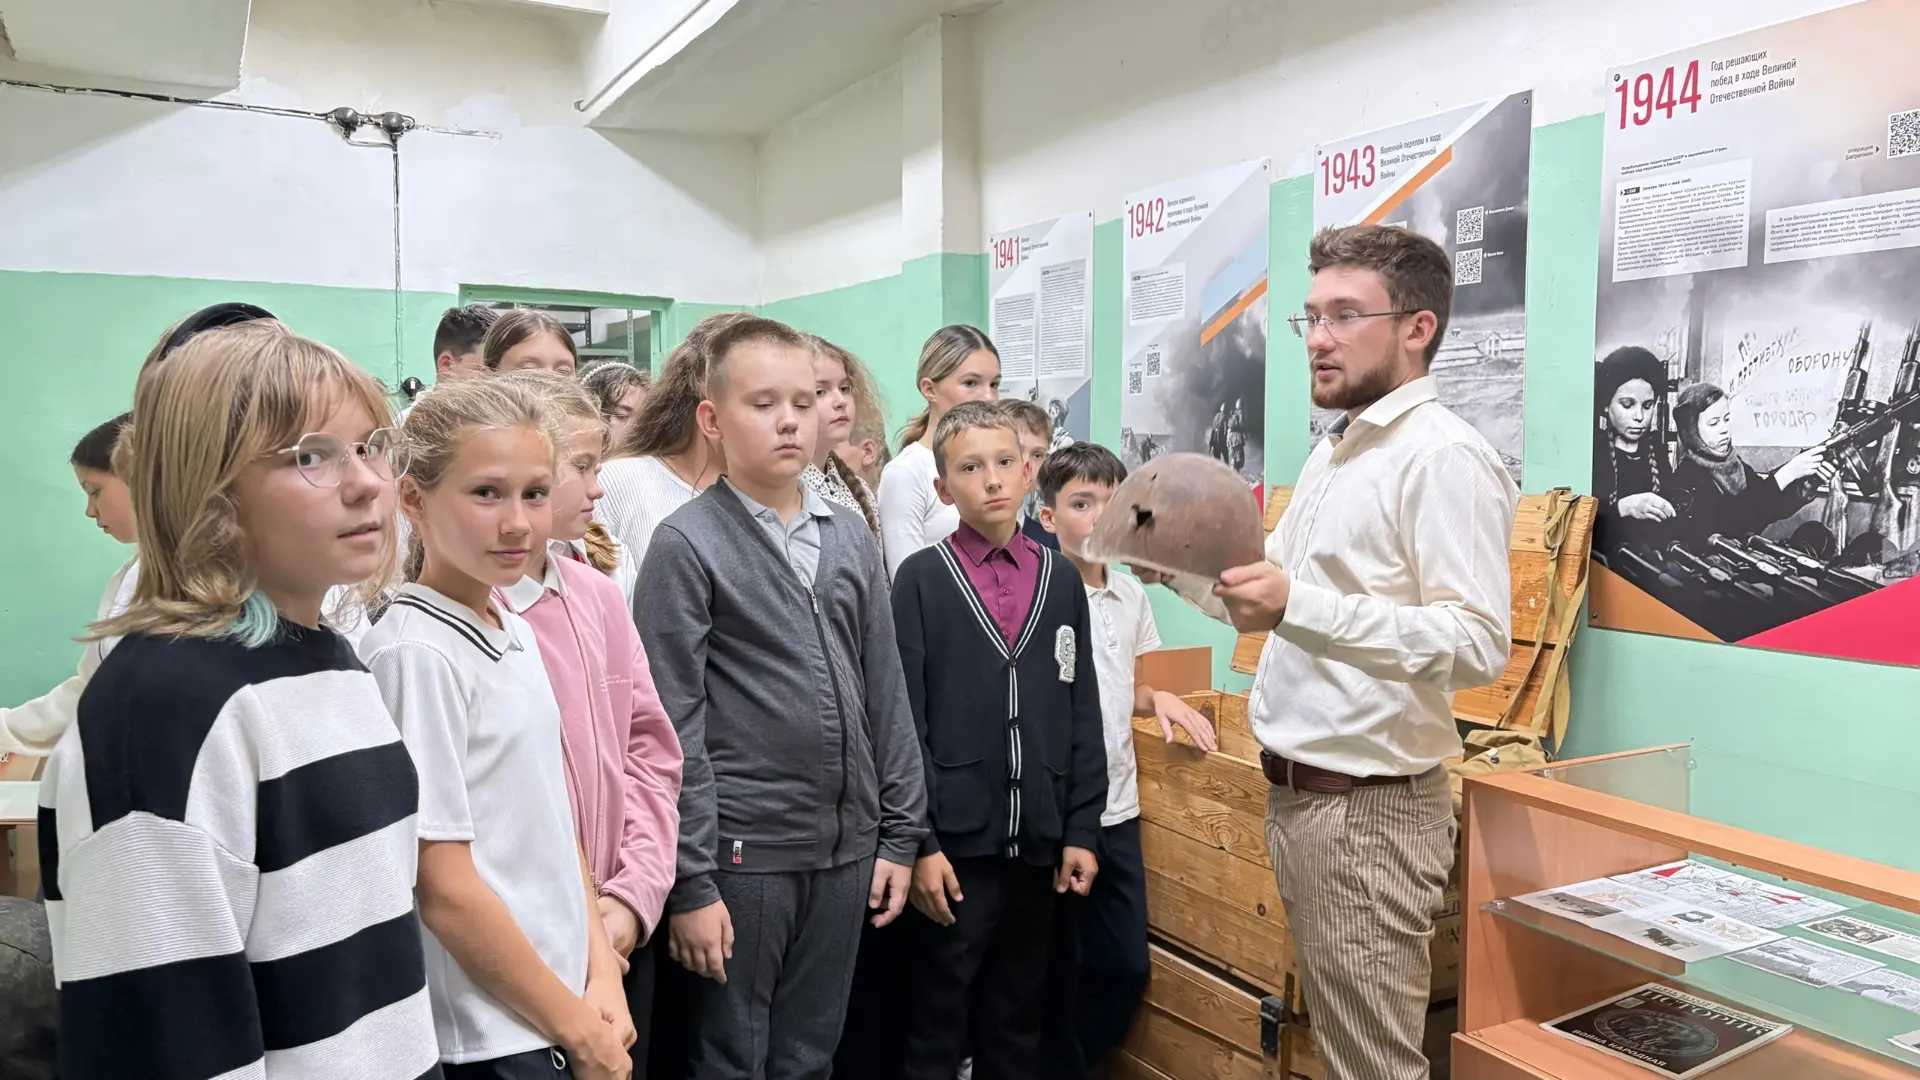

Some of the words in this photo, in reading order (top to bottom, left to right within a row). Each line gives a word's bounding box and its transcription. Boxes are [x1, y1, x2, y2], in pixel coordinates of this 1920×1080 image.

[1711, 60, 1724, 72] Год
[1726, 50, 1768, 70] решающих
[1615, 60, 1702, 130] 1944
[1710, 75, 1733, 88] побед
[1735, 74, 1740, 82] в
[1742, 69, 1760, 80] ходе
[1710, 82, 1767, 104] Отечественной
[1768, 78, 1795, 91] Войны
[1320, 144, 1376, 196] 1943
[1128, 198, 1164, 239] 1942
[994, 236, 1020, 270] 1941
[1788, 348, 1853, 374] ОБОРОНУ
[1572, 1030, 1607, 1044] ВОЙНА
[1608, 1043, 1667, 1066] НАРОДНАЯ
